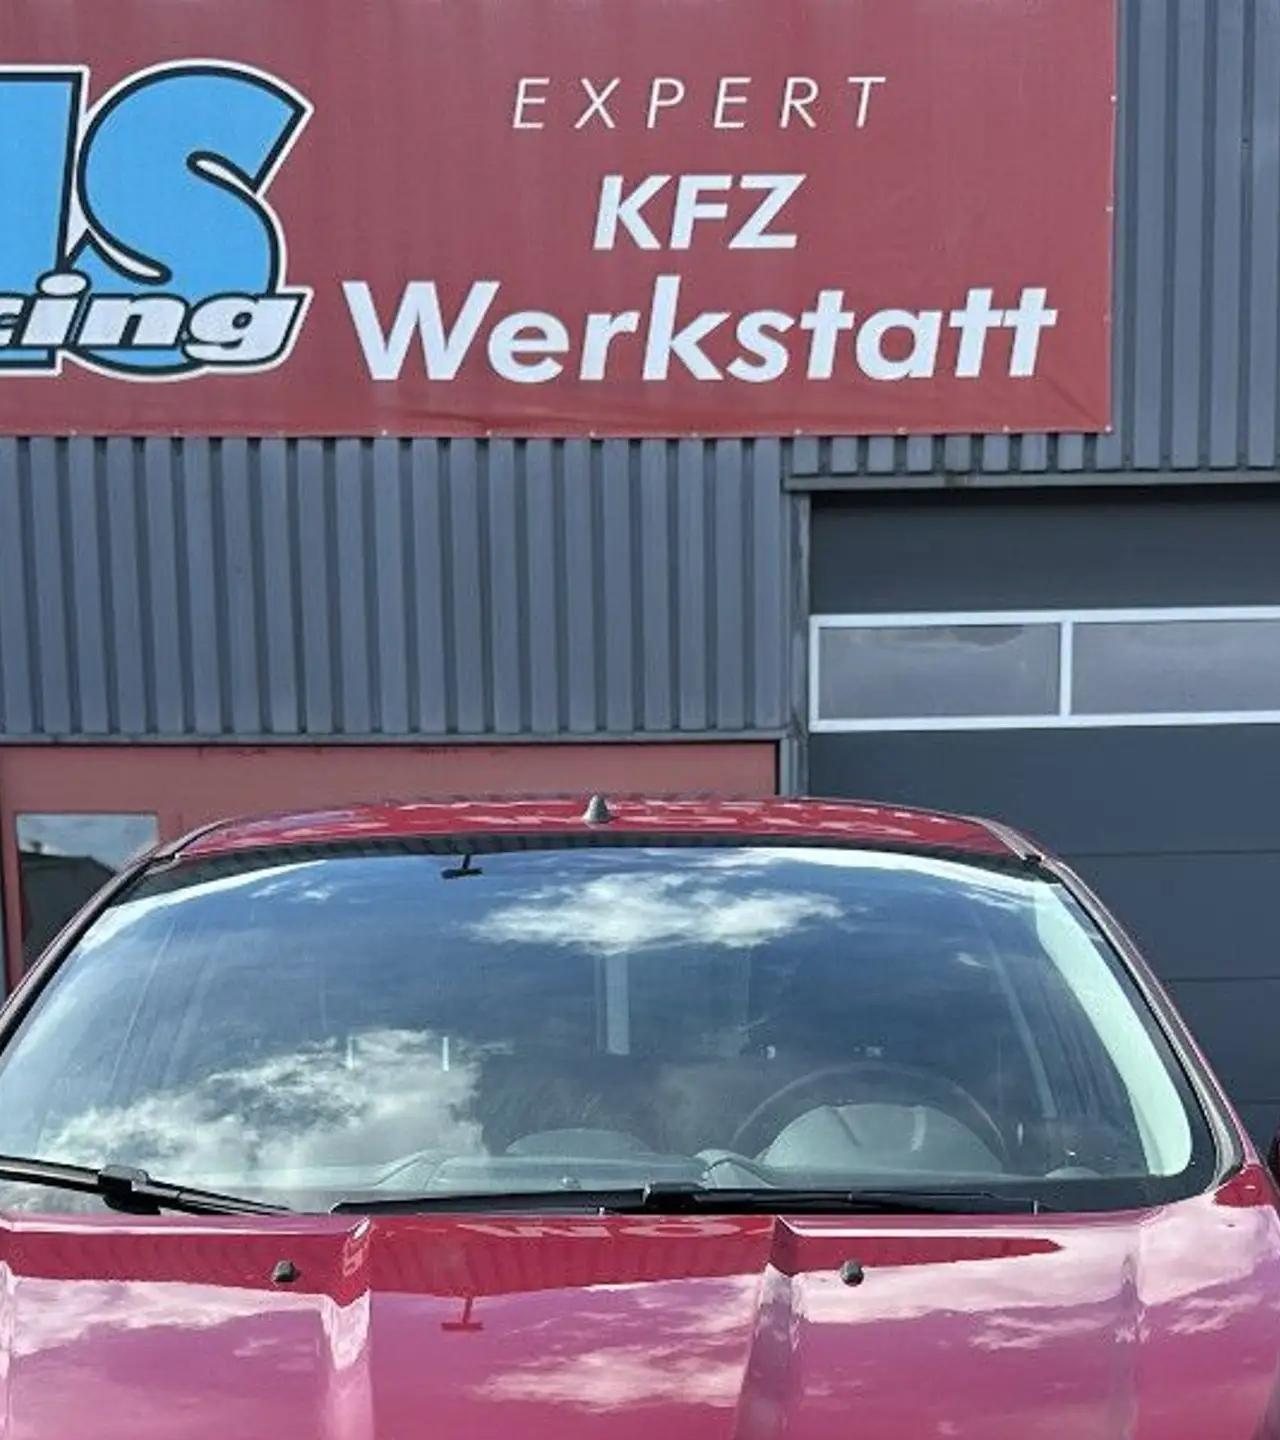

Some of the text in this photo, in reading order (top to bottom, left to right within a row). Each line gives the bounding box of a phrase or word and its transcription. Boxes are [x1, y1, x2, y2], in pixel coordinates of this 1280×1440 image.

[512, 77, 886, 129] EXPERT
[593, 174, 806, 251] KFZ
[341, 275, 1058, 382] Werkstatt
